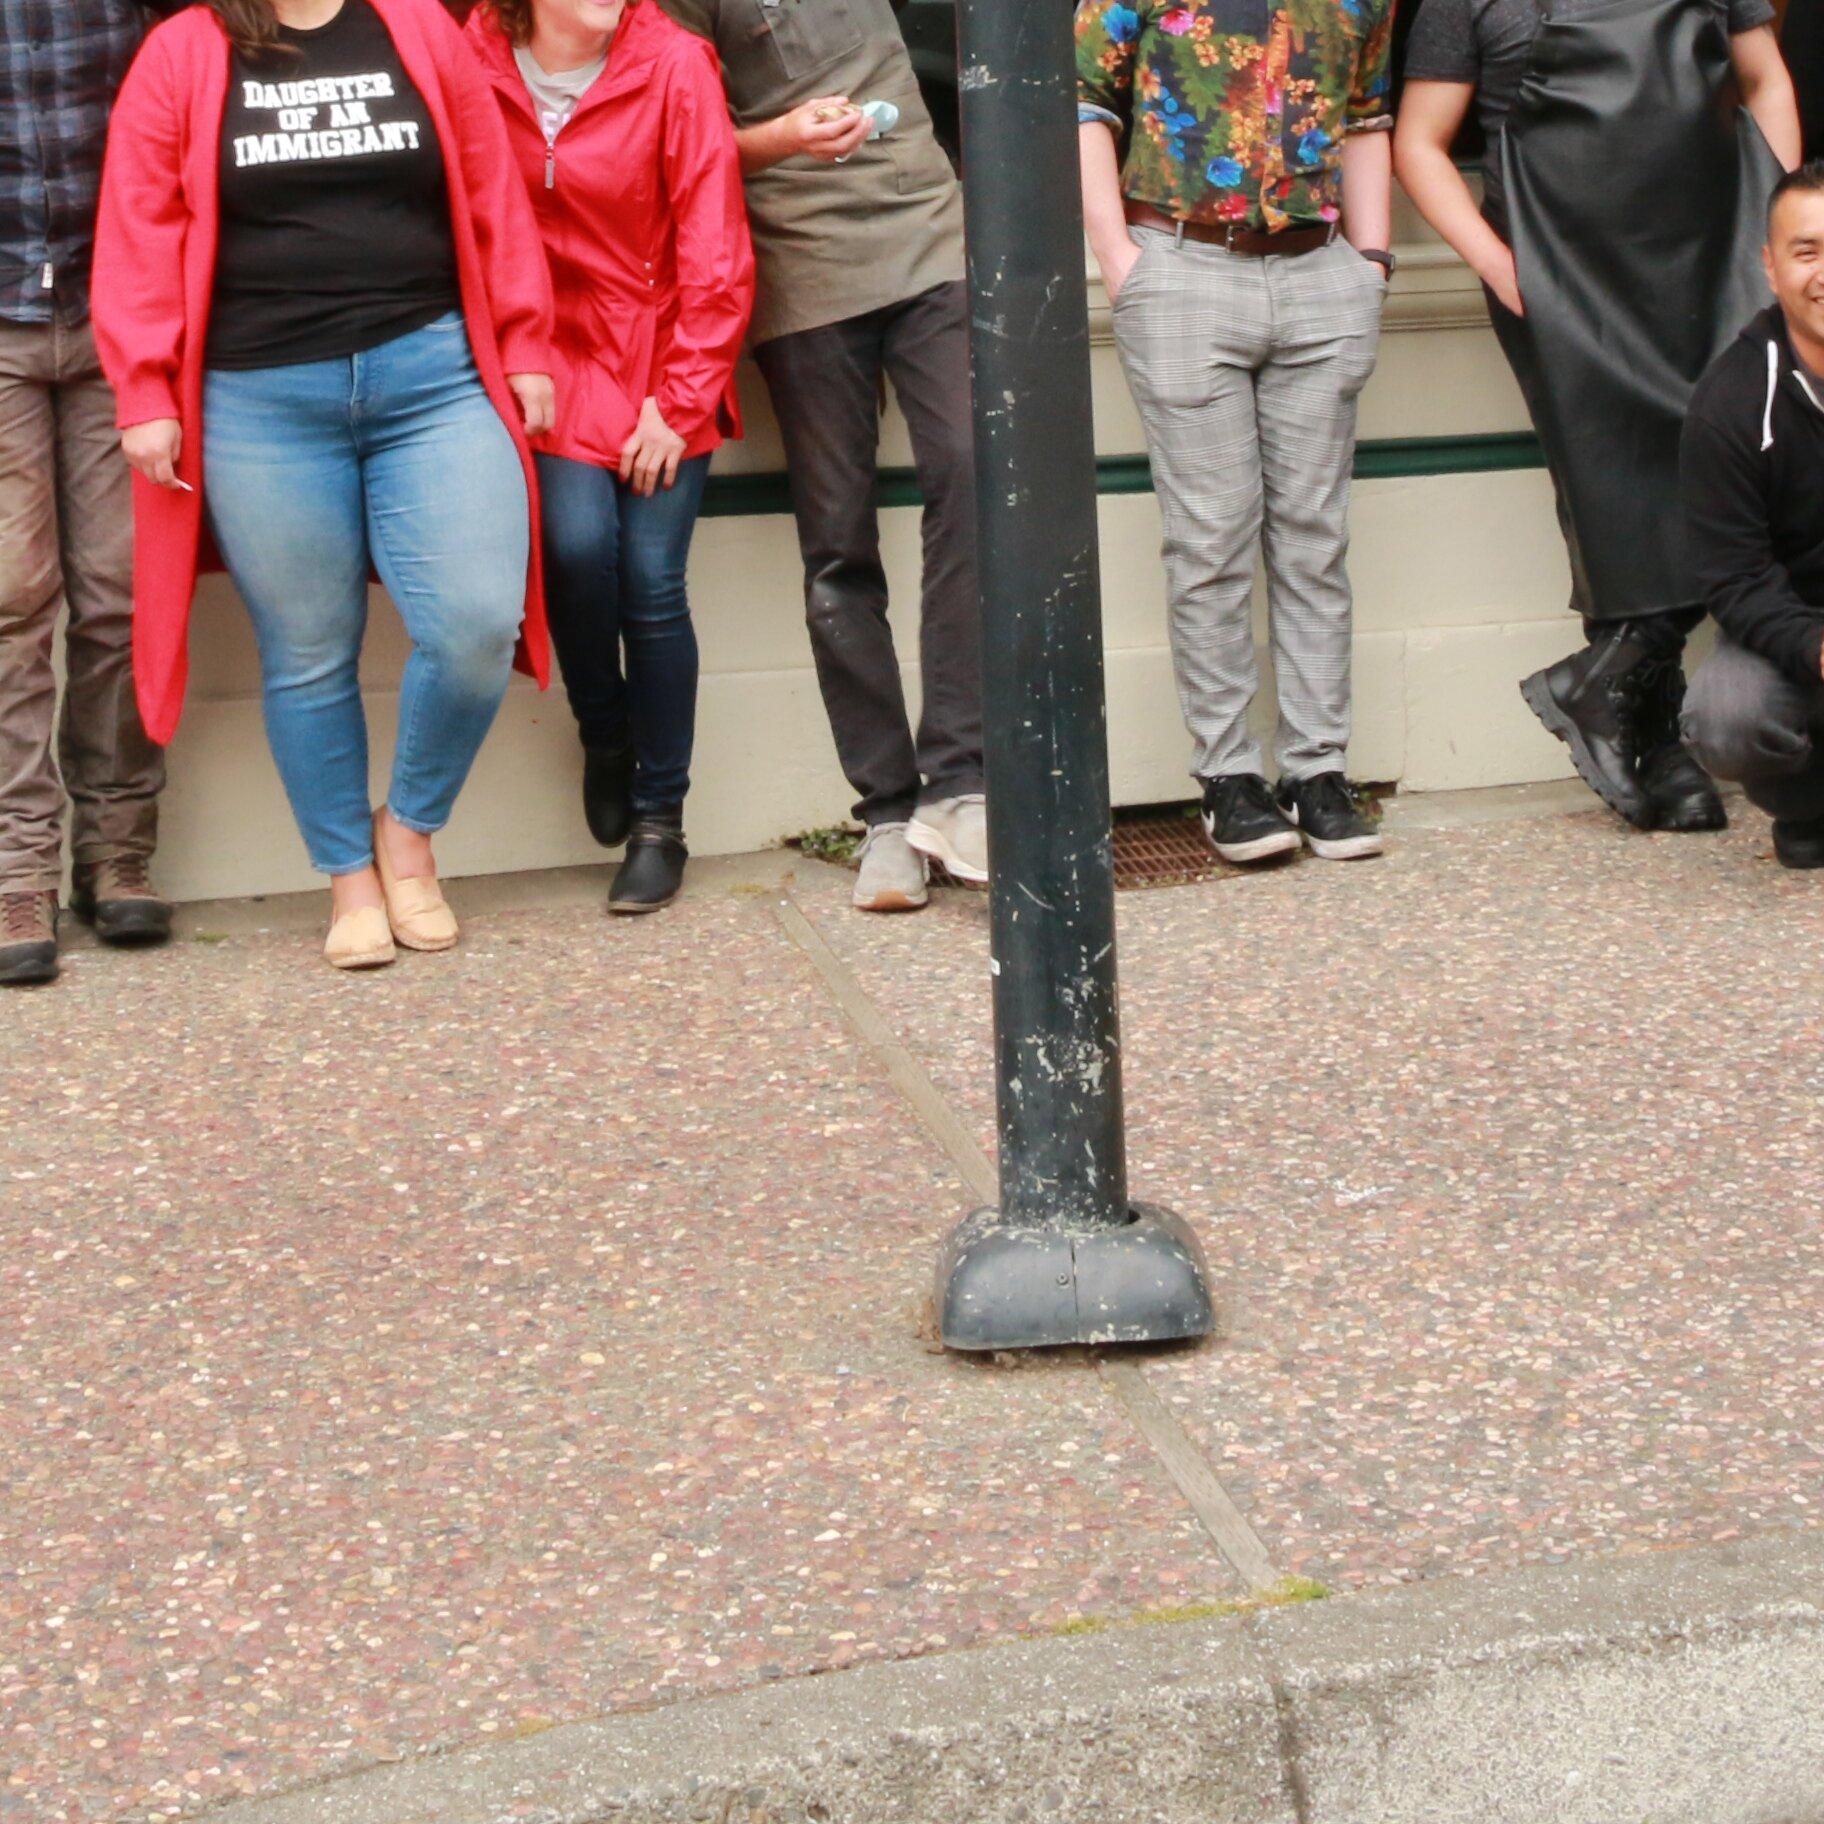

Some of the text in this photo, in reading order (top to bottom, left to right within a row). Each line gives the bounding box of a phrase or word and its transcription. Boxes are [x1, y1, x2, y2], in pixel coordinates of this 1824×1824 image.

[241, 72, 395, 109] DAUGHTER
[278, 101, 370, 132] OF AN
[232, 121, 421, 168] IMMIGRANT
